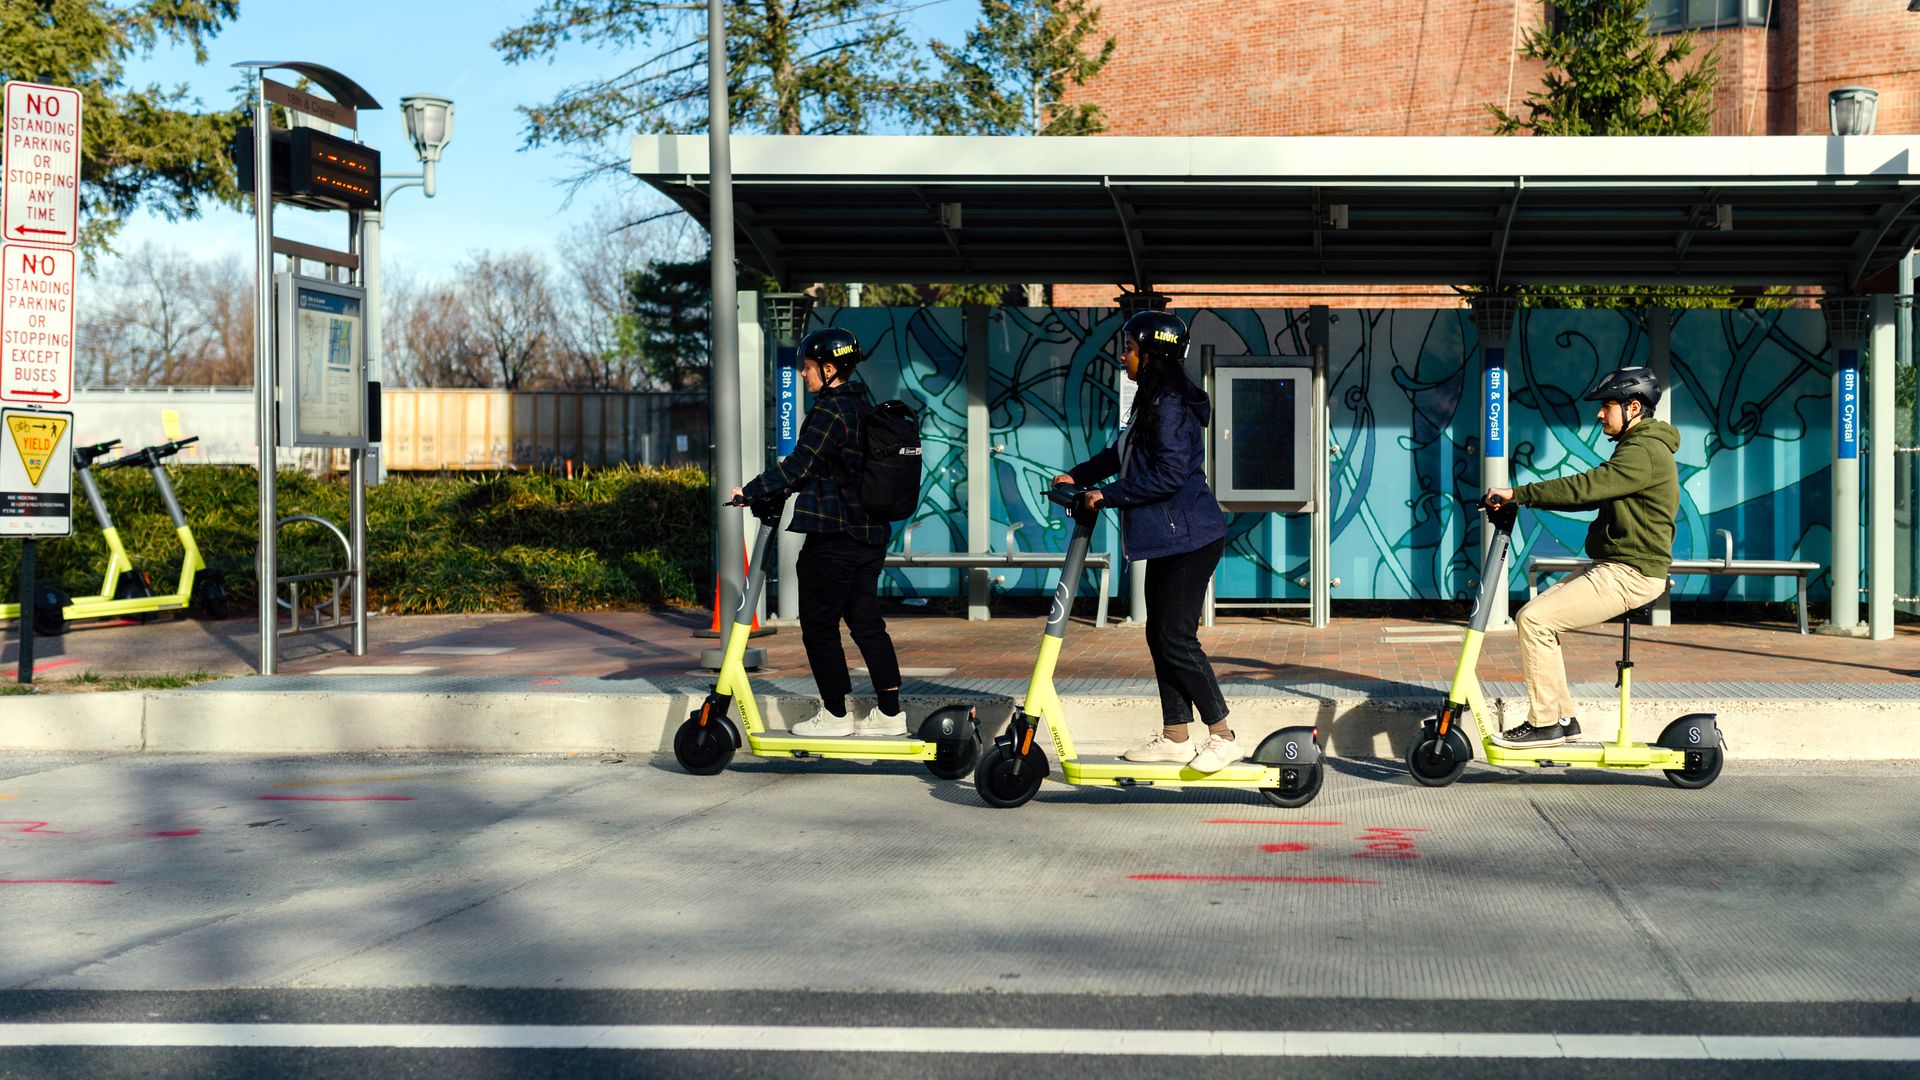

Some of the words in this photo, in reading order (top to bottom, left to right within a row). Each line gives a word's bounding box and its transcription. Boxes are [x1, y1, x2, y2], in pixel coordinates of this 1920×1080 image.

[27, 94, 60, 117] NO
[11, 117, 75, 137] STANDING
[14, 135, 71, 153] PARKING
[34, 154, 51, 169] OR
[9, 169, 74, 189] STOPPING
[28, 189, 55, 204] ANY
[26, 206, 56, 222] TIME
[22, 253, 55, 276] NO
[6, 278, 70, 295] STANDING
[9, 295, 66, 312] PARKING
[28, 314, 46, 328] OR
[4, 330, 69, 347] STOPPING
[1154, 330, 1179, 344] LINK
[12, 348, 60, 364] EXCEPT
[832, 344, 854, 357] LINK
[14, 367, 57, 382] BUSES
[782, 366, 792, 388] 18th
[1491, 366, 1500, 389] 18th
[1845, 368, 1854, 391] 18th
[782, 390, 792, 399] &
[1491, 391, 1500, 400] &
[1845, 393, 1854, 402] &
[781, 402, 792, 440] Crystal
[1489, 403, 1500, 441] Crystal
[1842, 404, 1854, 442] Crystal
[23, 437, 50, 451] YIELD
